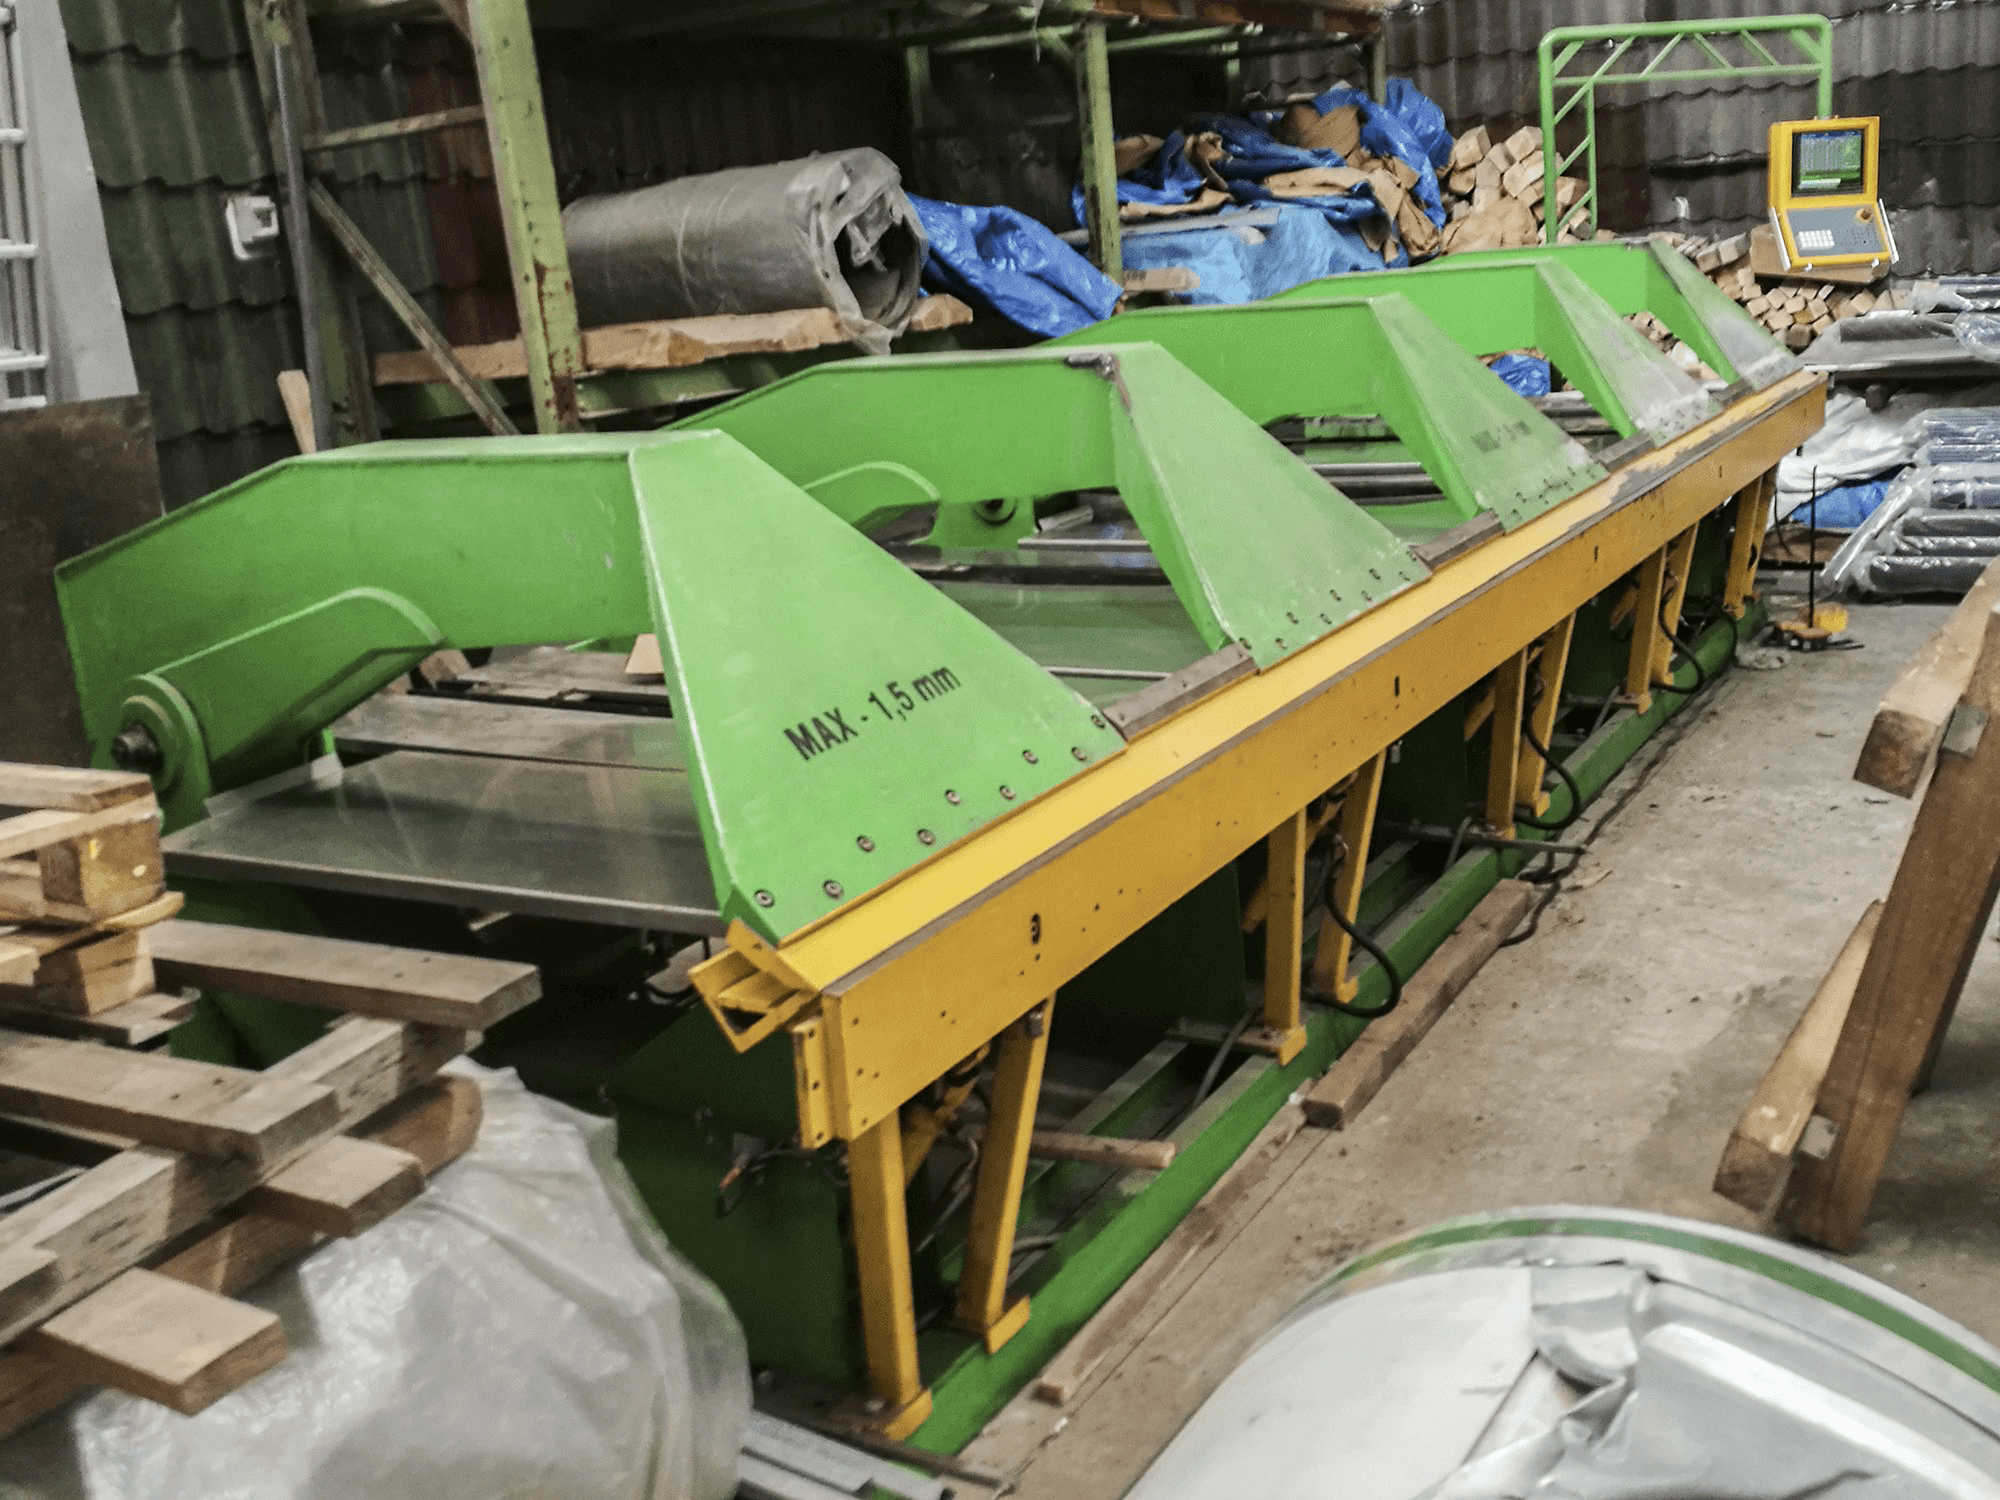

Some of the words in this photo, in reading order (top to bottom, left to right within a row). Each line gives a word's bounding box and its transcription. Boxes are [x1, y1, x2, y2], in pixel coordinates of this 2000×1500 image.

[784, 707, 858, 760] MAX
[868, 681, 915, 721] 1,5
[912, 667, 961, 701] mm
